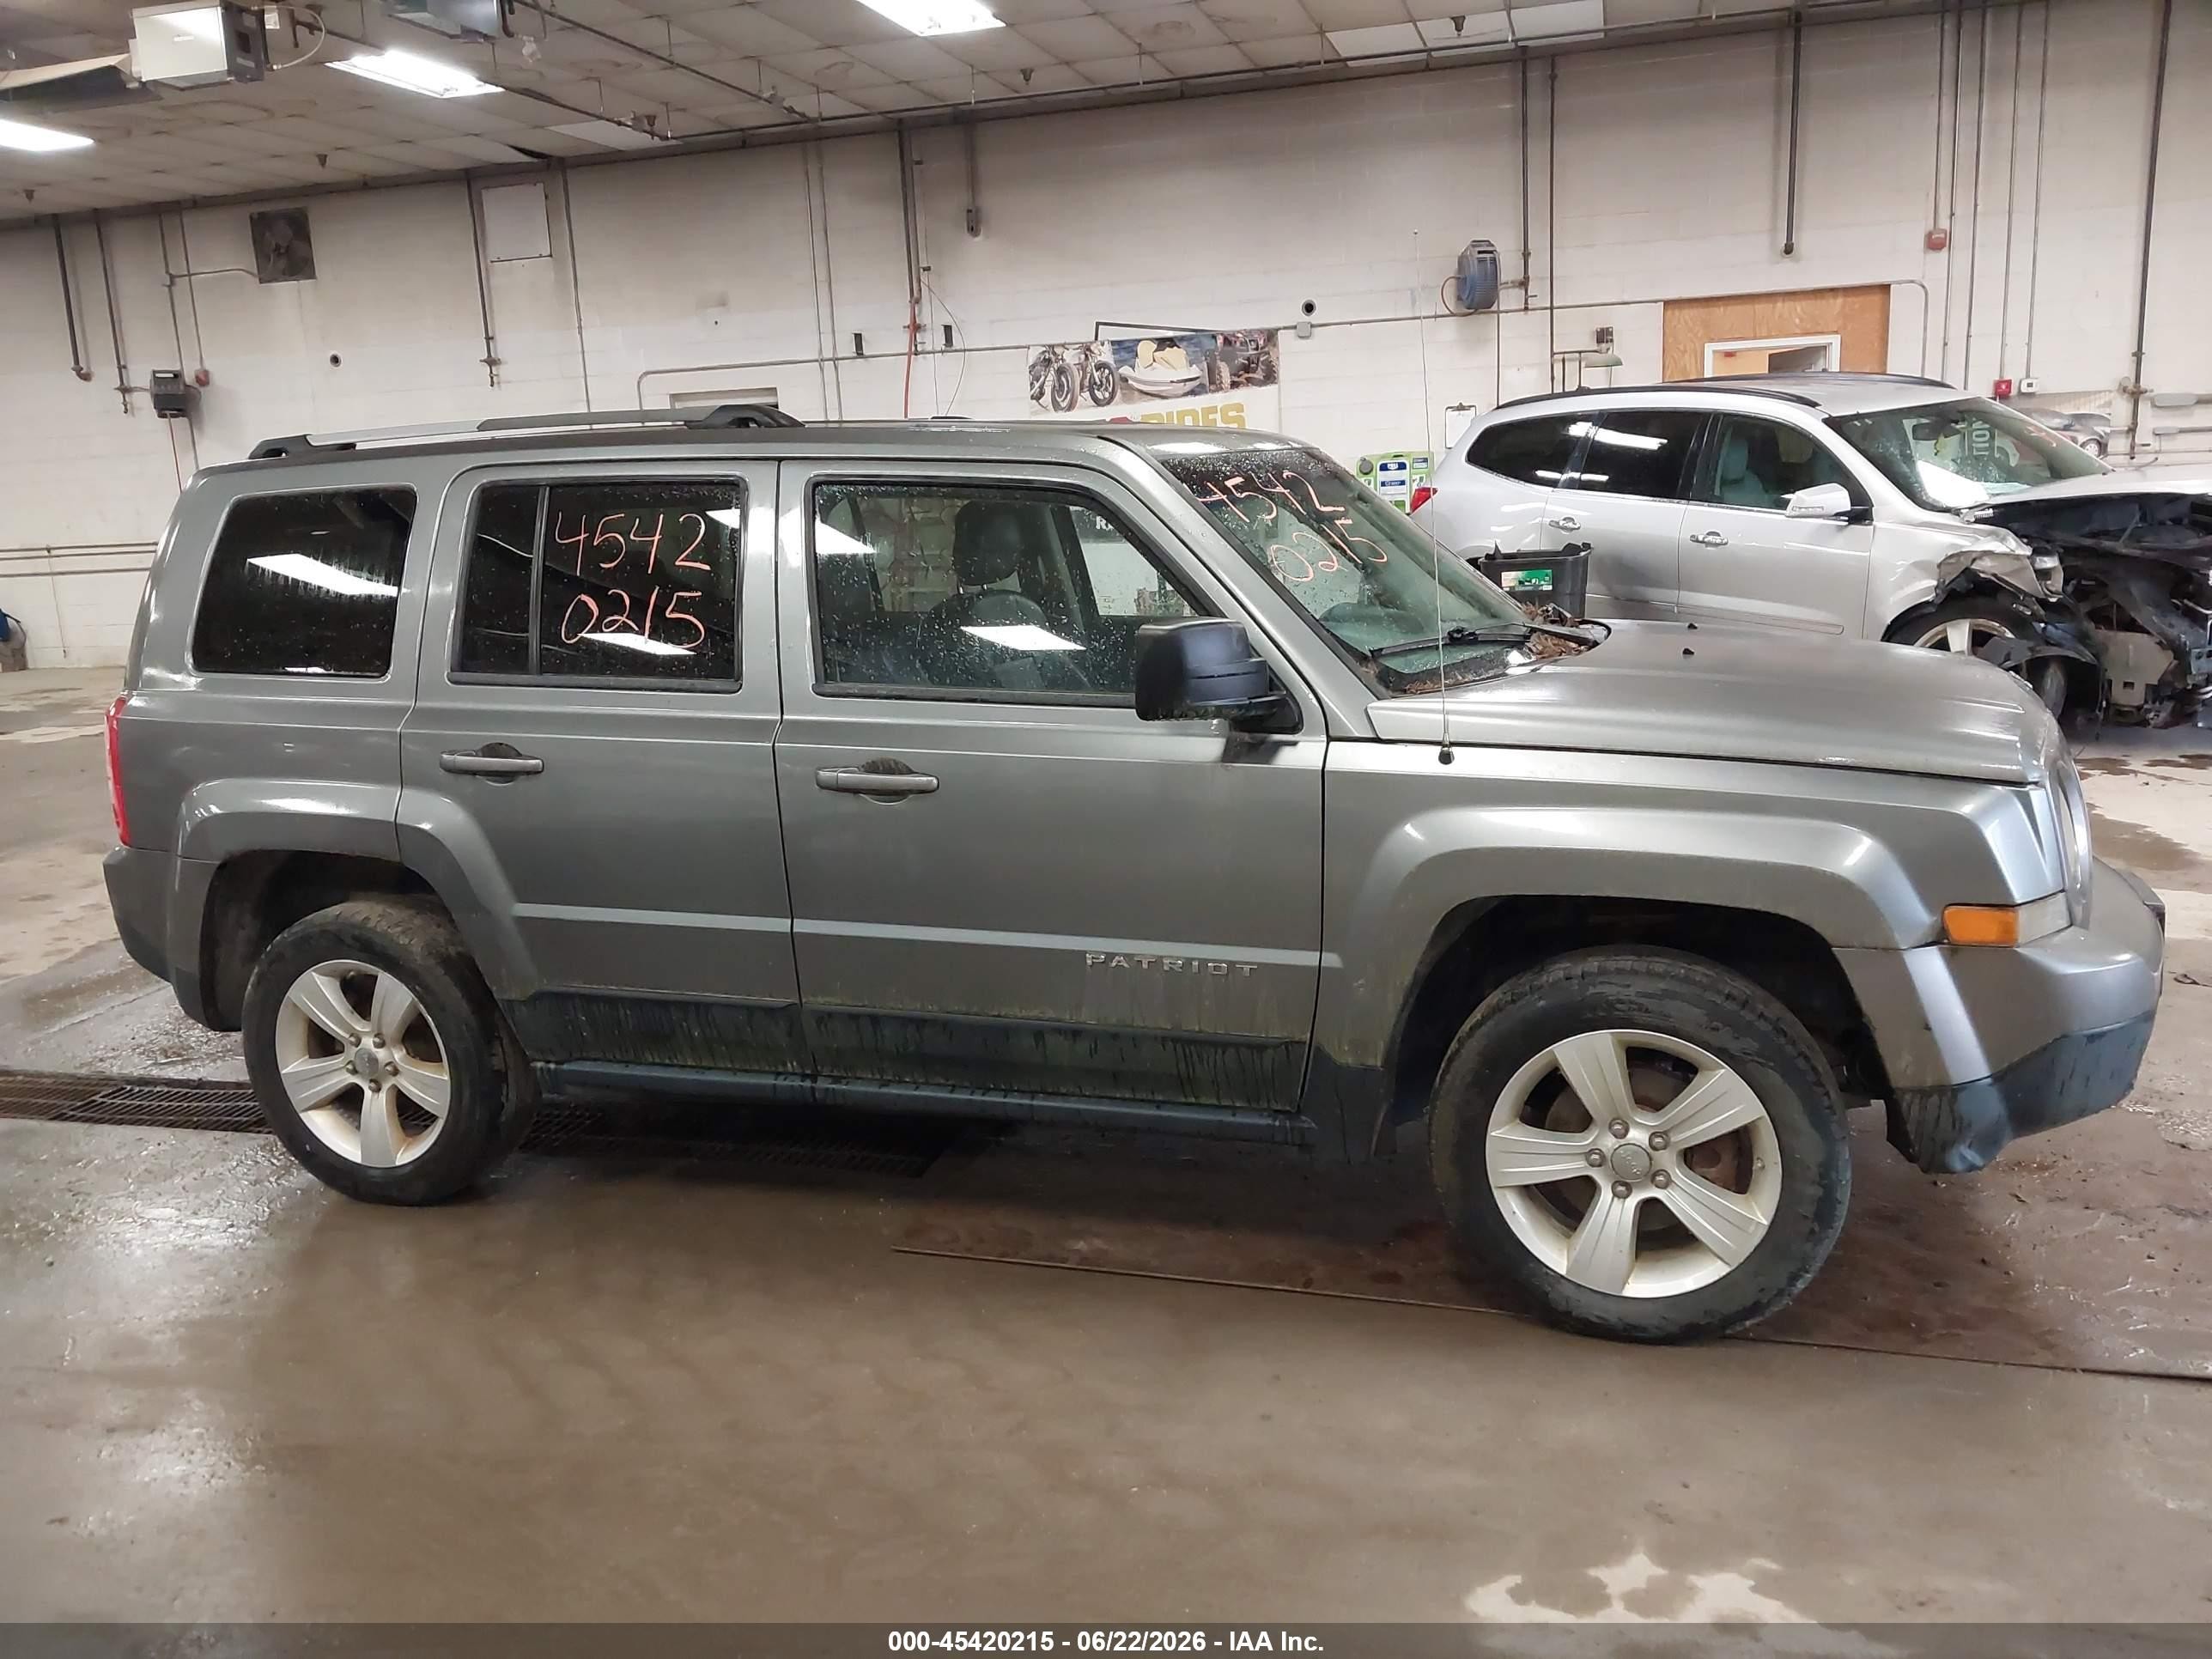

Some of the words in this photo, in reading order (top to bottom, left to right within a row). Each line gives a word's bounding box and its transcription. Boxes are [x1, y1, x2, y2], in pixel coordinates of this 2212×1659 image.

[555, 511, 712, 576] 4542
[1269, 518, 1389, 582] 0215
[561, 586, 706, 649] 0215
[1085, 951, 1258, 977] PATRIOT
